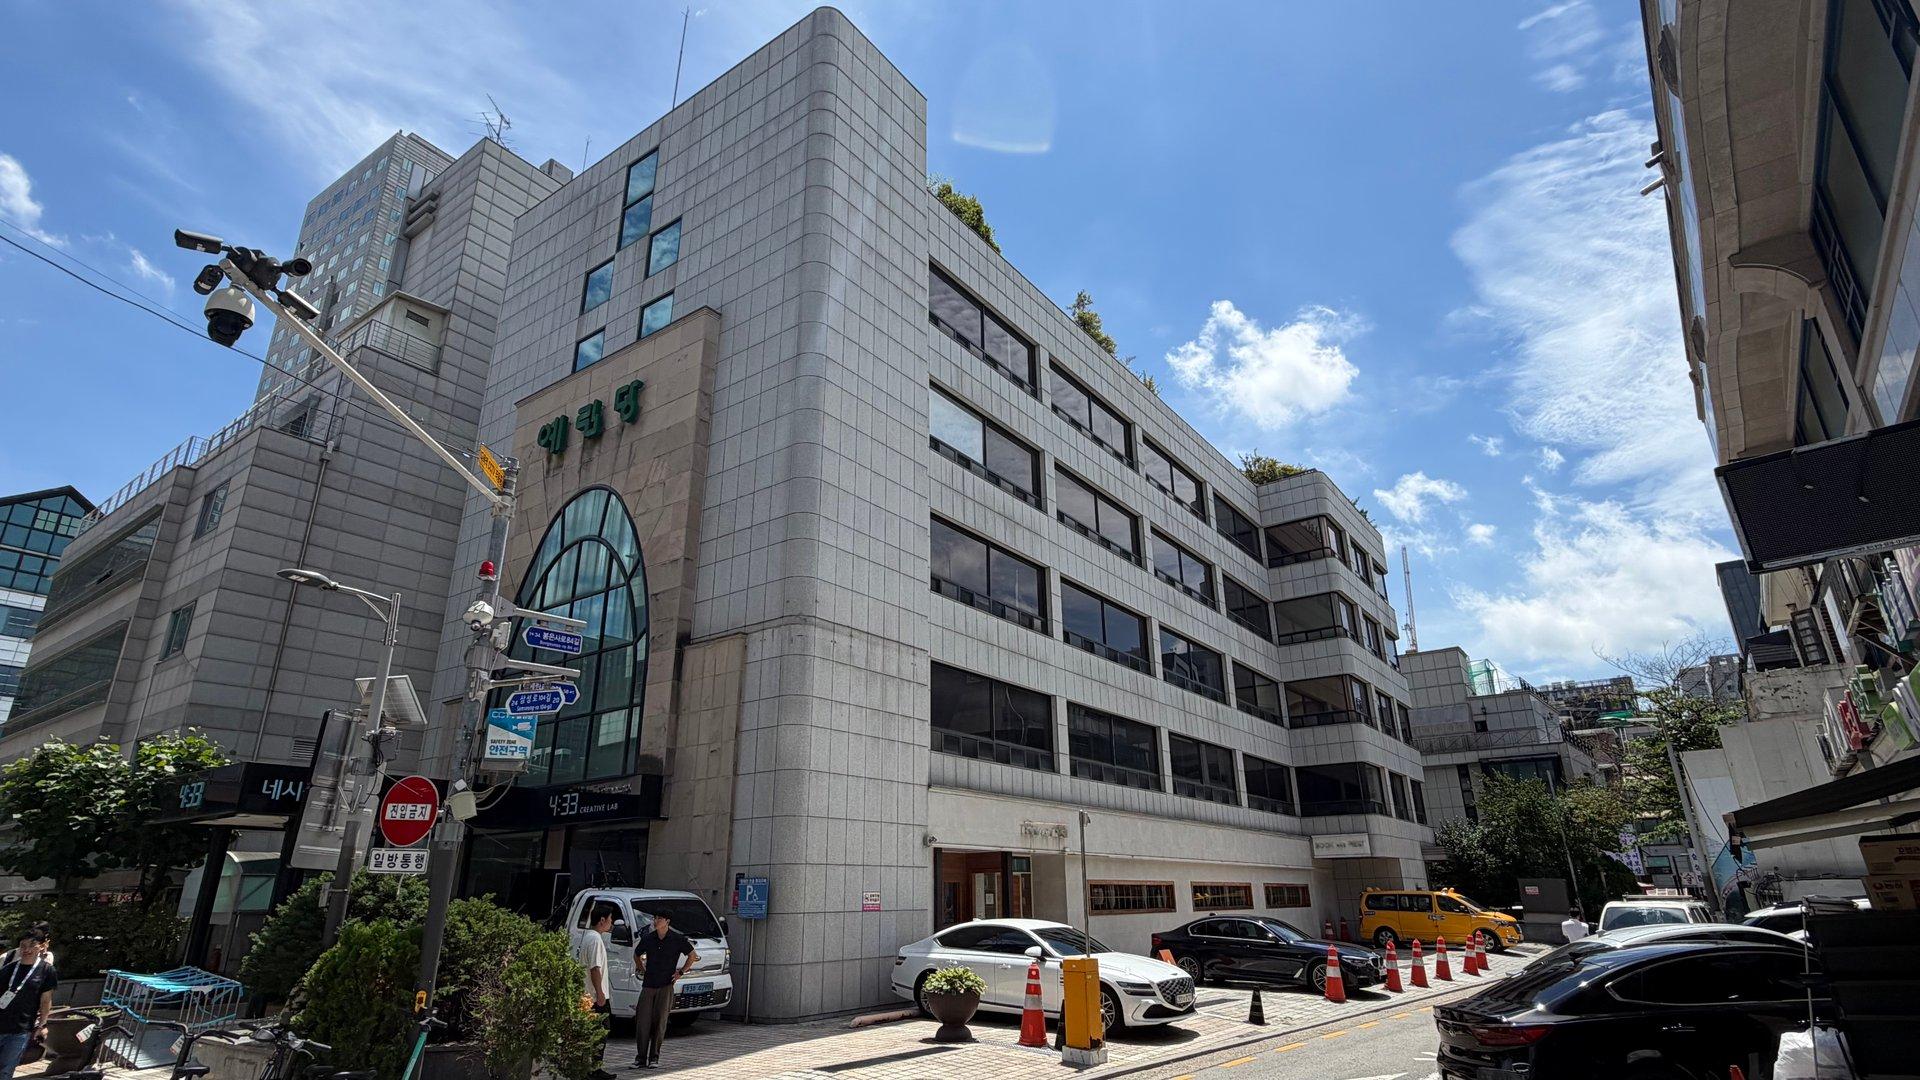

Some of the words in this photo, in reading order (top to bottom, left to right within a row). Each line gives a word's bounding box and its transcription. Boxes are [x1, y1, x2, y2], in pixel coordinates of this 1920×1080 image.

[537, 379, 645, 455] 예림당
[542, 632, 580, 645] 봉은사로84길
[489, 744, 528, 756] 안전구역
[390, 804, 428, 819] 진입금지
[549, 793, 579, 816] 4:33
[580, 804, 606, 814] CREATIVE
[607, 802, 619, 811] LAB
[373, 853, 425, 869] 일방통행
